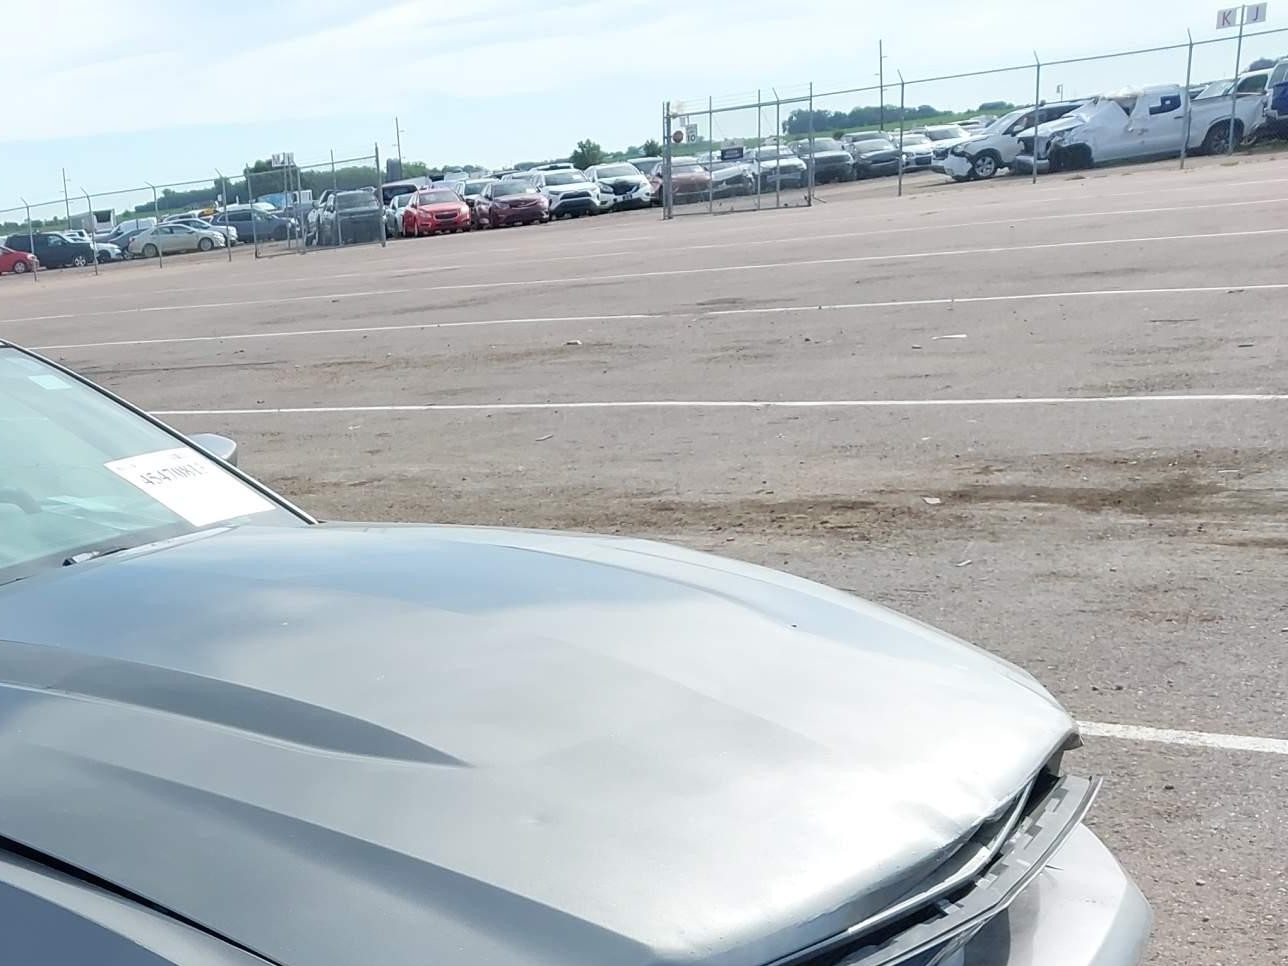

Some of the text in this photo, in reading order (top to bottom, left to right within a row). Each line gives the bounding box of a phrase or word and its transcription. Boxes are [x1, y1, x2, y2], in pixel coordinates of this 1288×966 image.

[1222, 6, 1260, 26] K J
[687, 133, 697, 143] 10
